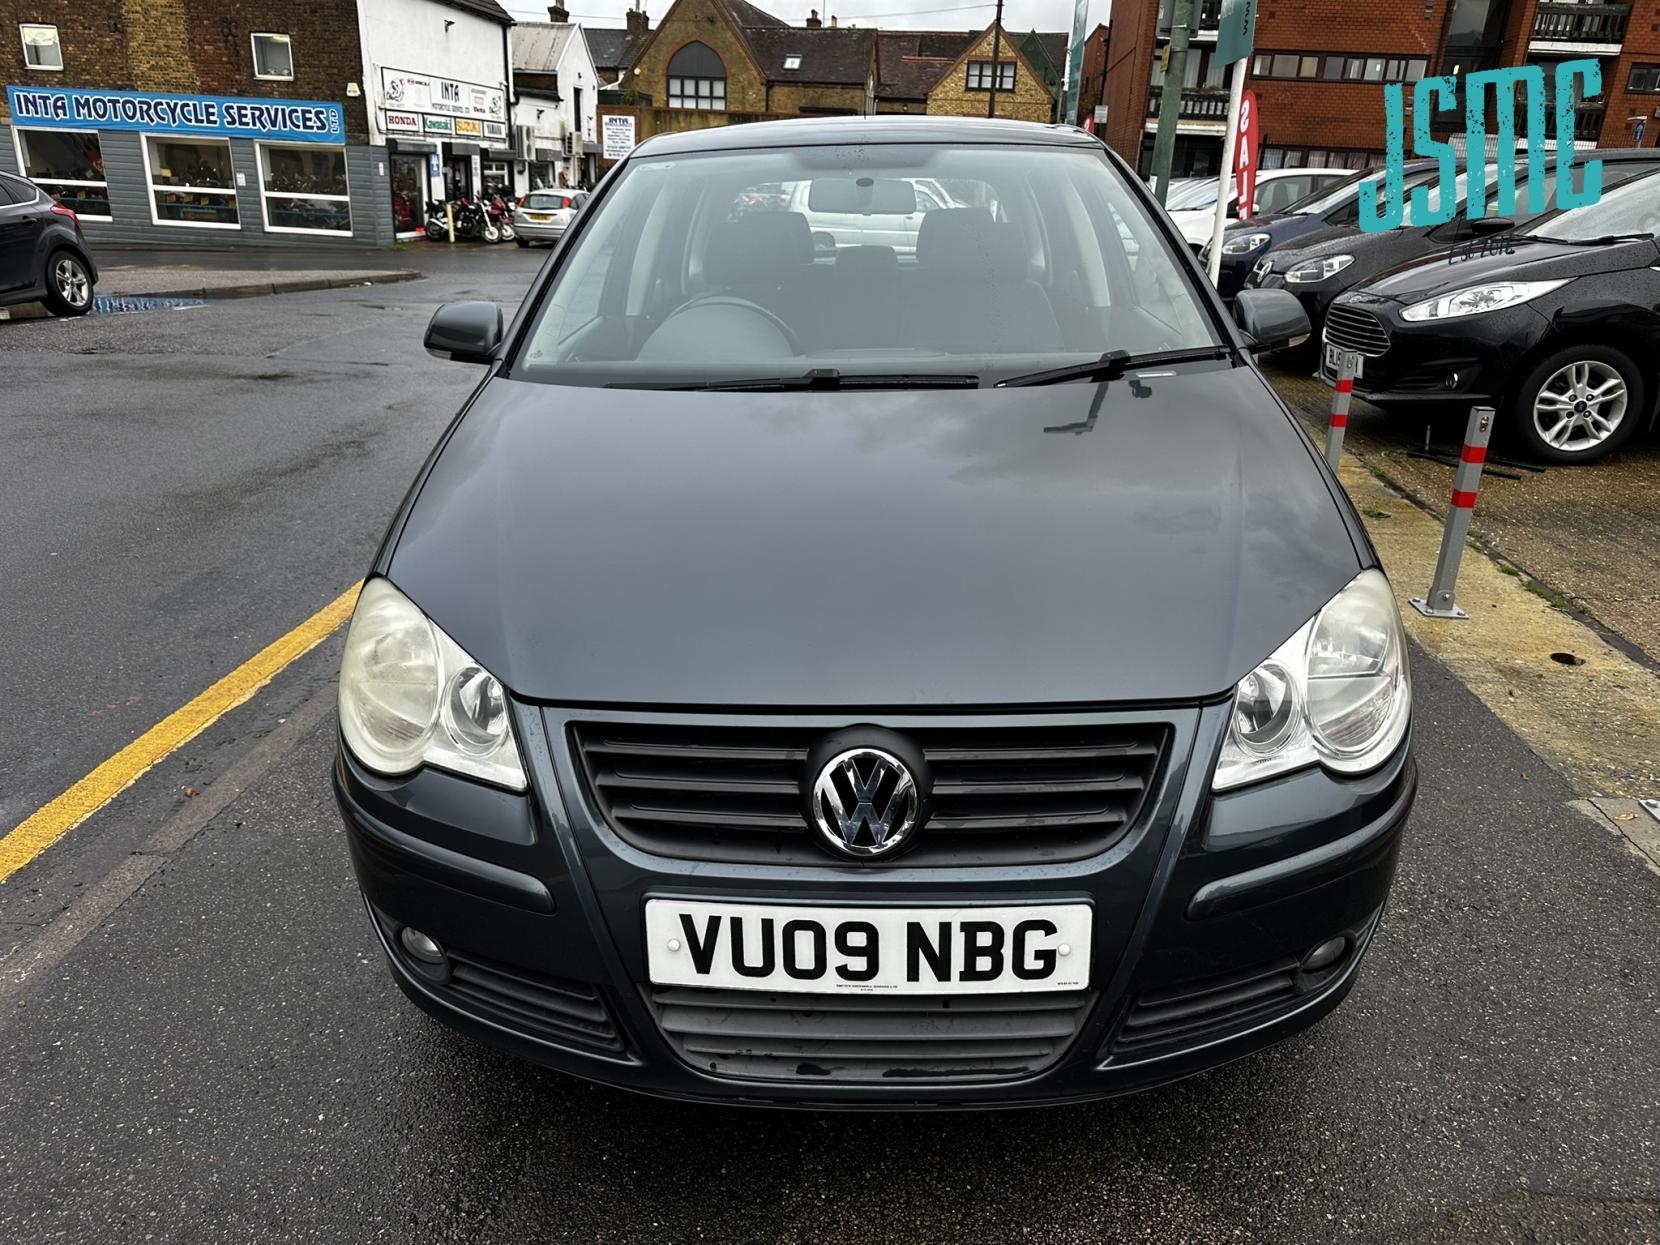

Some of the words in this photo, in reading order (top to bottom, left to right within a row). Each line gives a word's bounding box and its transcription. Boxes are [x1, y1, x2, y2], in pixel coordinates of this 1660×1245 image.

[441, 81, 460, 102] INTA
[13, 92, 68, 119] INTA
[72, 95, 219, 126] MOTORCYCLE
[224, 103, 328, 132] SERVICES
[329, 109, 340, 134] LTD
[388, 115, 417, 126] HONDA
[424, 117, 452, 131] Kawasaki
[456, 120, 480, 133] SUZUKI
[678, 913, 880, 982] VU09
[906, 919, 1058, 982] NBG
